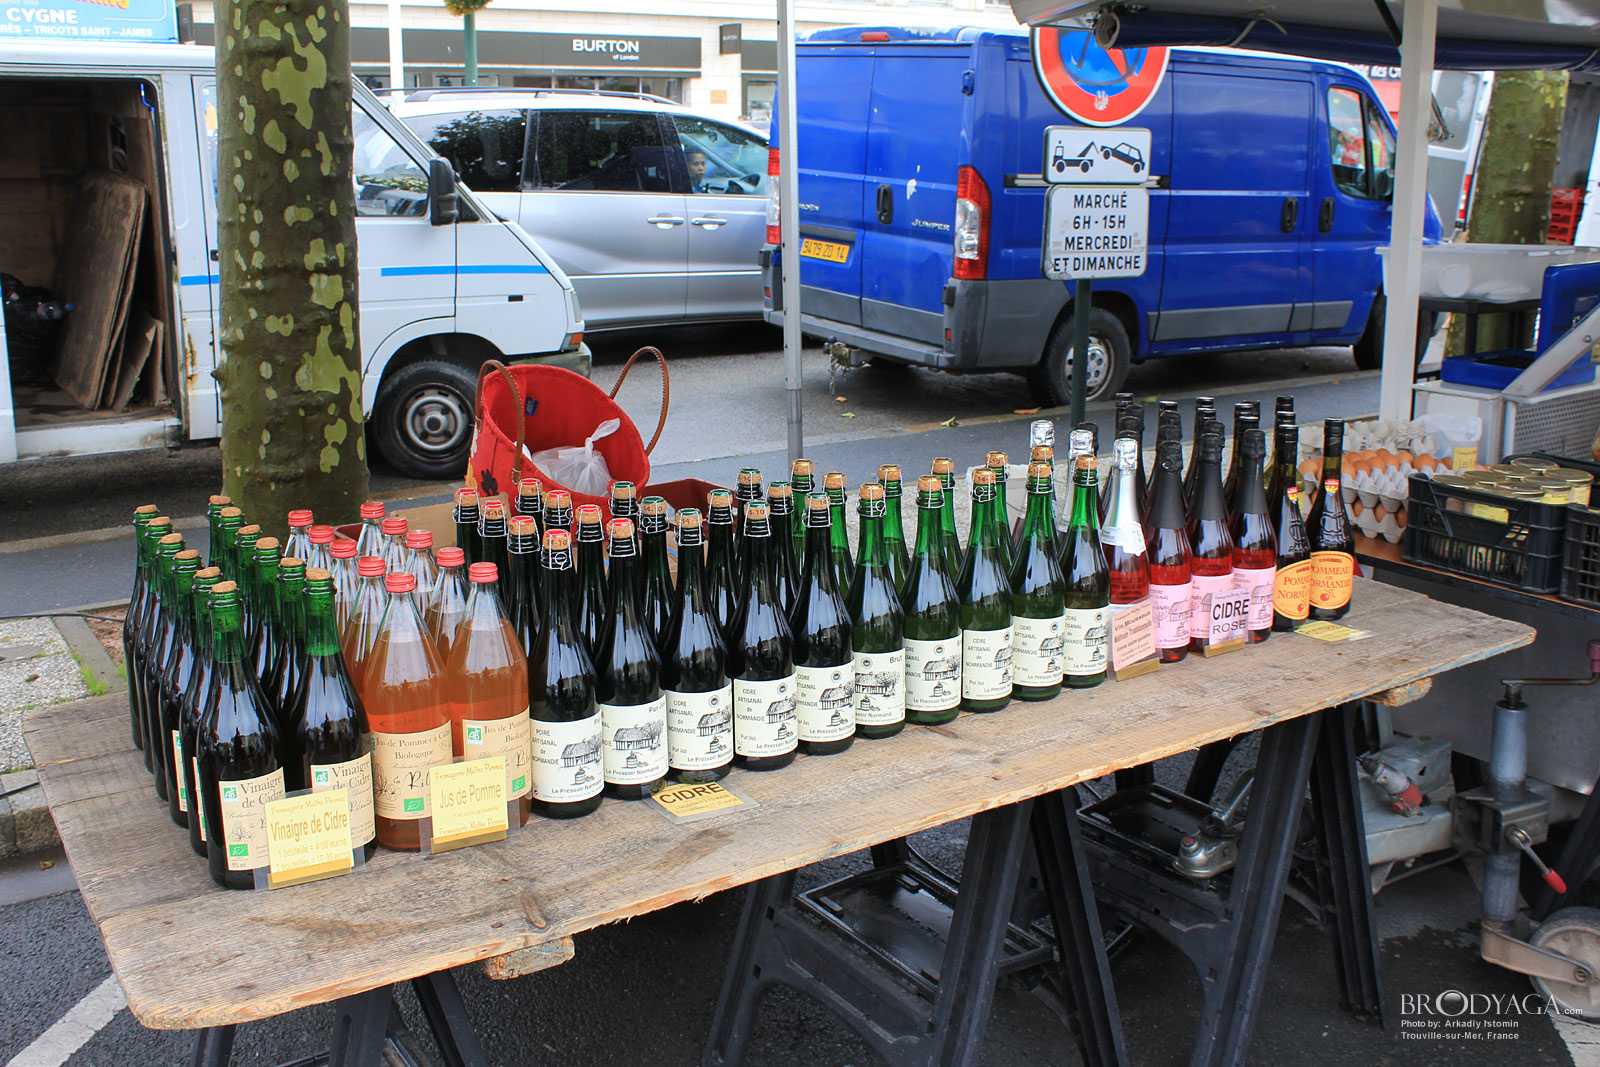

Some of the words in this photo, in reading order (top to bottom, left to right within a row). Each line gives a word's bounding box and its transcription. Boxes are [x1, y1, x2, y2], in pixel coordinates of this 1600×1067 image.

[6, 7, 78, 24] CYGNE
[33, 25, 79, 36] TRICOTS
[572, 39, 640, 53] BURTON
[1073, 191, 1128, 209] MARCHÉ
[911, 218, 951, 232] JUMPER
[1072, 215, 1091, 230] 6H
[1102, 215, 1126, 230] 15H
[1064, 235, 1132, 251] MERCREDI
[1053, 257, 1069, 272] ET
[1072, 255, 1141, 271] DIMANCHE
[1310, 578, 1352, 589] ORMANDIE
[1212, 598, 1251, 621] CIDRE
[1114, 622, 1125, 632] Vin
[1212, 619, 1247, 635] ROSE
[889, 655, 903, 664] Brut
[737, 696, 763, 704] ARTISANAL
[648, 705, 659, 714] Pur
[668, 707, 694, 716] ARTISANAL
[736, 713, 765, 722] NORMANDIE
[483, 724, 496, 735] Jus
[498, 724, 507, 733] de
[535, 728, 551, 737] POIRÉ
[668, 725, 696, 735] NORMANDIE
[387, 739, 397, 747] de
[399, 736, 433, 748] Pommes
[532, 737, 558, 747] ARTISANAL
[763, 741, 784, 749] Pressoir
[394, 749, 435, 760] Biologique
[694, 755, 717, 763] Pressoir
[532, 756, 560, 765] NORMANDIE
[331, 759, 370, 778] Vinaigre
[636, 766, 660, 775] Normand
[240, 774, 283, 795] Vinaigre
[348, 774, 371, 789] Cidre
[560, 786, 584, 794] Pressoir
[659, 783, 725, 804] CIDRE
[440, 789, 454, 809] Jus
[456, 786, 468, 806] de
[469, 783, 502, 803] Pomme
[241, 797, 255, 809] de
[270, 819, 309, 842] Vinaigre
[310, 813, 322, 834] de
[323, 809, 348, 832] Cidre
